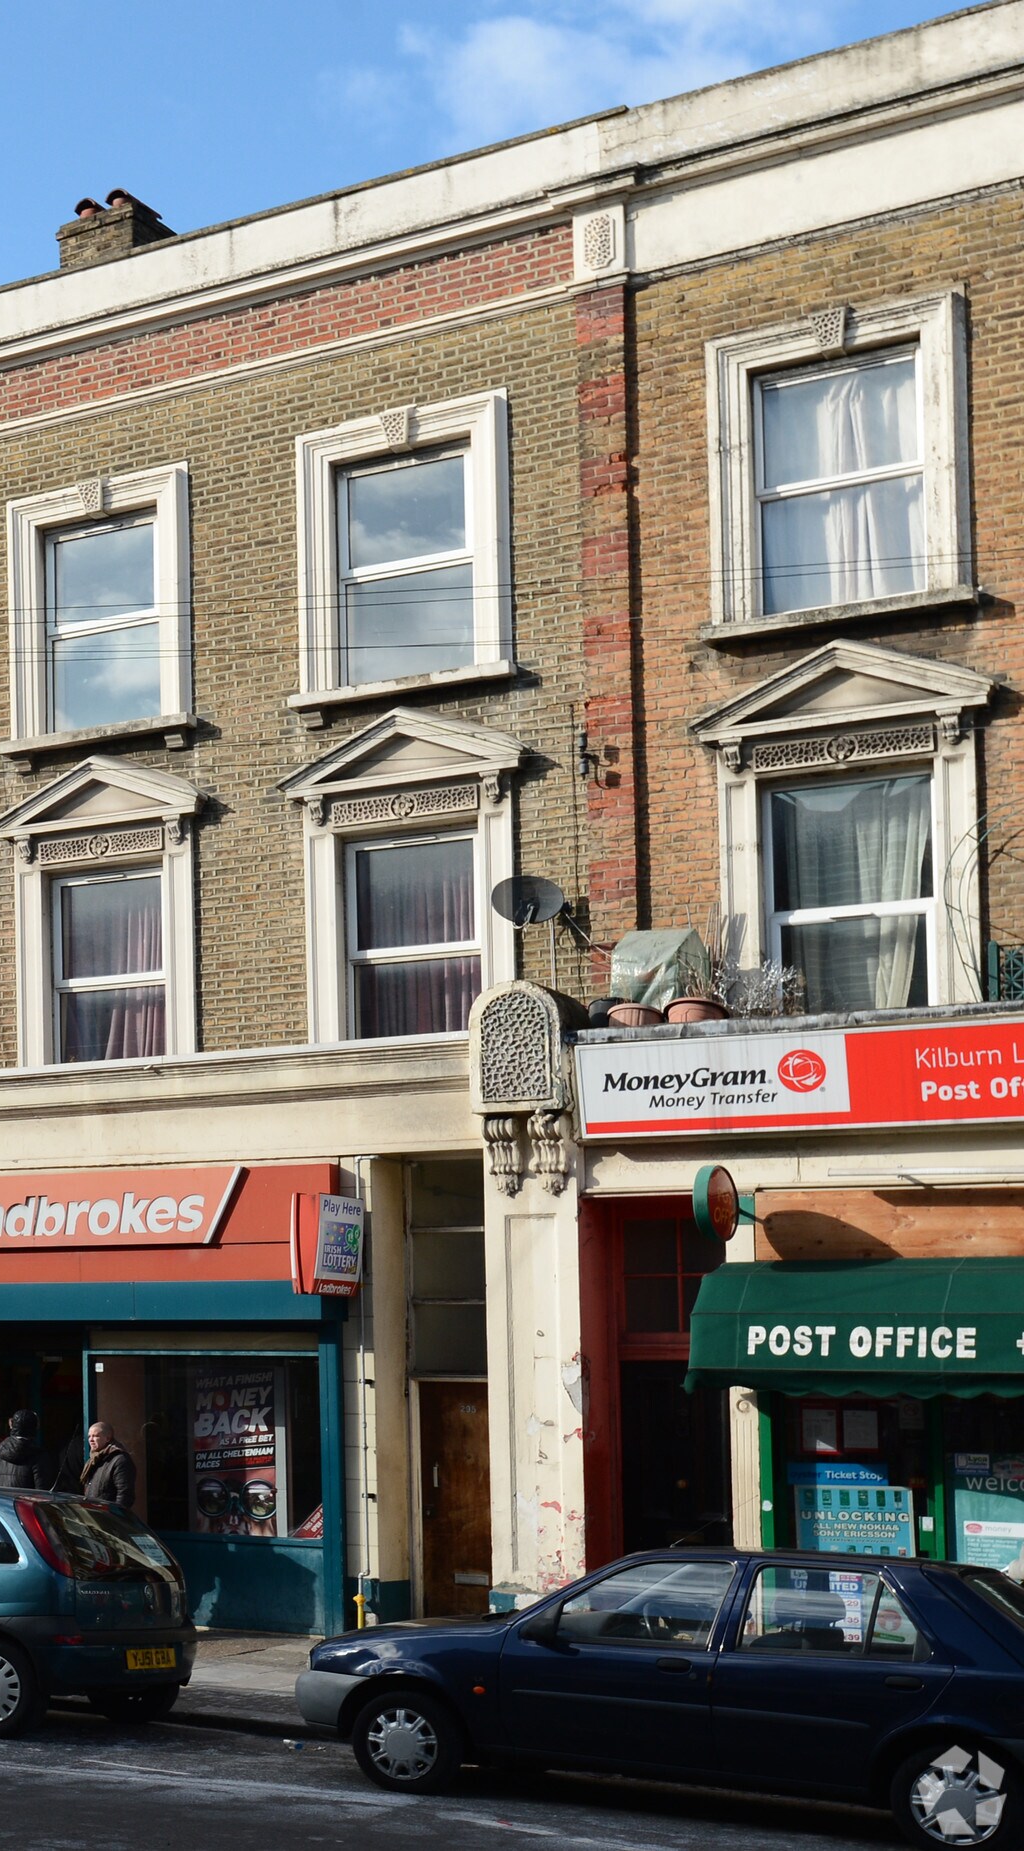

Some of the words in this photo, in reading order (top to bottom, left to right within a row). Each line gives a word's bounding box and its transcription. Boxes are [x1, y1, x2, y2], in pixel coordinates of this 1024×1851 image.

[915, 1046, 1002, 1069] Kilburn
[602, 1067, 767, 1094] MoneyGram
[921, 1080, 981, 1102] Post
[990, 1076, 1024, 1099] Of
[649, 1094, 705, 1110] Money
[710, 1089, 778, 1106] Transfer
[323, 1199, 341, 1216] Play
[342, 1202, 361, 1216] Here
[324, 1244, 342, 1254] IRISH
[323, 1254, 357, 1268] LOTTERY
[319, 1283, 352, 1295] Ladbrokes
[747, 1325, 836, 1356] POST
[849, 1326, 976, 1358] OFFICE
[196, 1376, 226, 1389] WHAT
[226, 1375, 233, 1386] A
[234, 1371, 273, 1385] FINISH!
[196, 1386, 273, 1411] MONEY
[194, 1407, 273, 1438] BACK
[219, 1439, 230, 1447] AS
[238, 1435, 257, 1444] FREE
[258, 1434, 274, 1443] BET
[195, 1453, 206, 1461] ON
[207, 1451, 222, 1460] ALL
[222, 1446, 274, 1459] CHELTENHAM
[195, 1460, 221, 1469] RACES
[824, 1470, 857, 1480] Ticket
[859, 1470, 884, 1482] Stop
[801, 1511, 910, 1522] UNLOCKING
